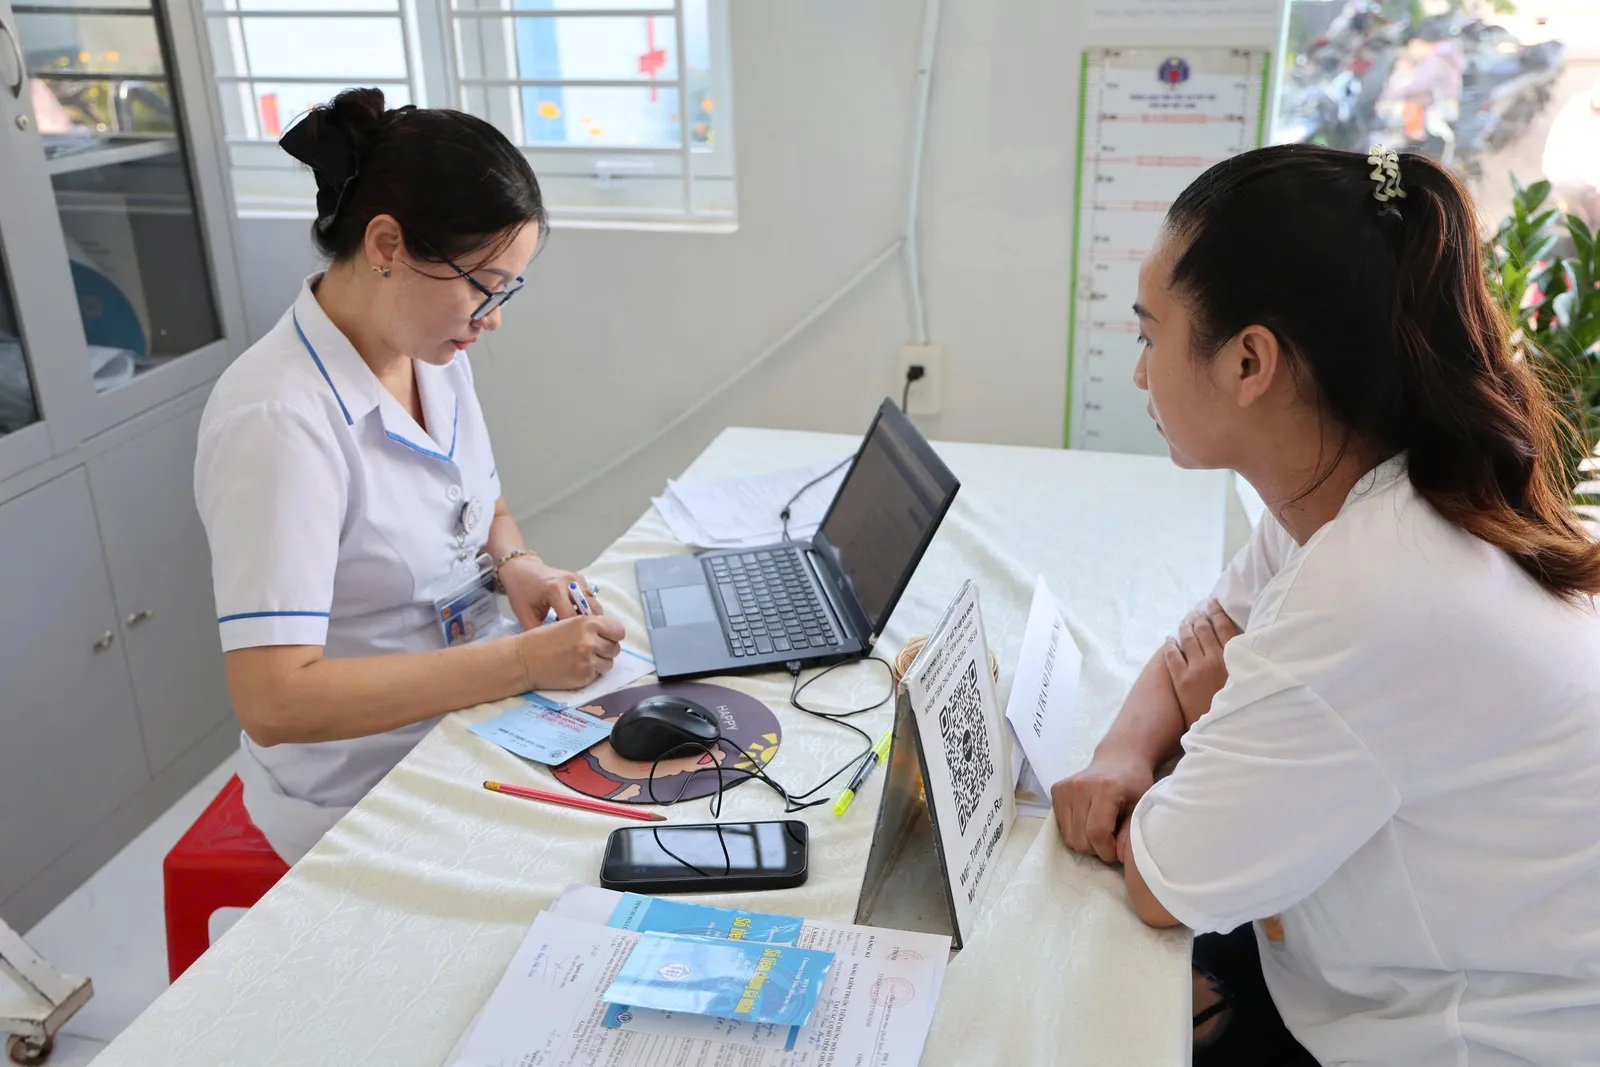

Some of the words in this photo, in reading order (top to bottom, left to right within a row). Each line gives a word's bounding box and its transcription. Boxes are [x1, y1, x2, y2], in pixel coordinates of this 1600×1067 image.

[716, 704, 738, 730] HAPPY
[728, 928, 745, 940] tiê
[762, 948, 781, 958] Sổ
[757, 956, 776, 972] tiêm
